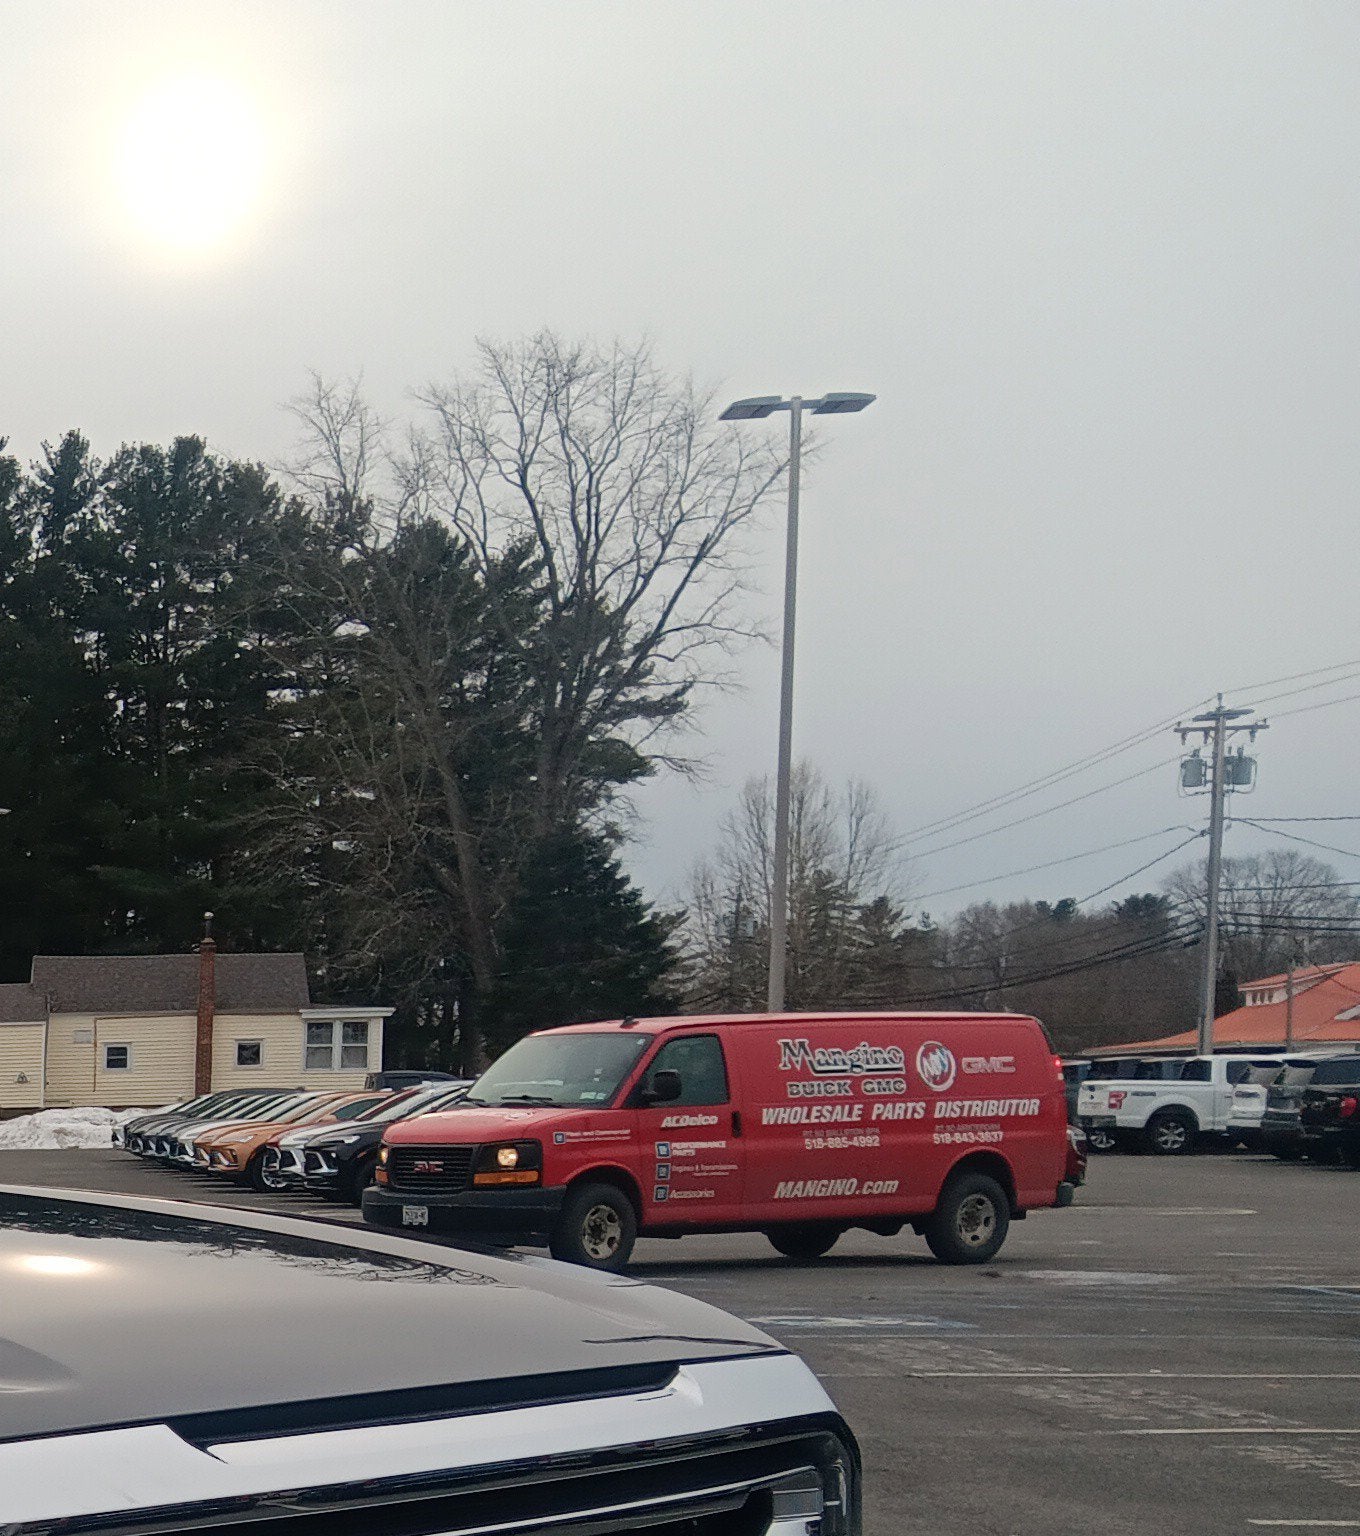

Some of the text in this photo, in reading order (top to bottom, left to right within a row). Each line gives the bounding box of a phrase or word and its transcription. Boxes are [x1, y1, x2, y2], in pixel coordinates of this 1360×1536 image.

[777, 1038, 906, 1077] Mangino
[962, 1056, 1016, 1074] GMC
[787, 1078, 907, 1098] BUICK GMC
[761, 1099, 1041, 1125] WHOLESALE PARTS DISTRIBUTOR
[774, 1178, 899, 1199] MANGINO.com
